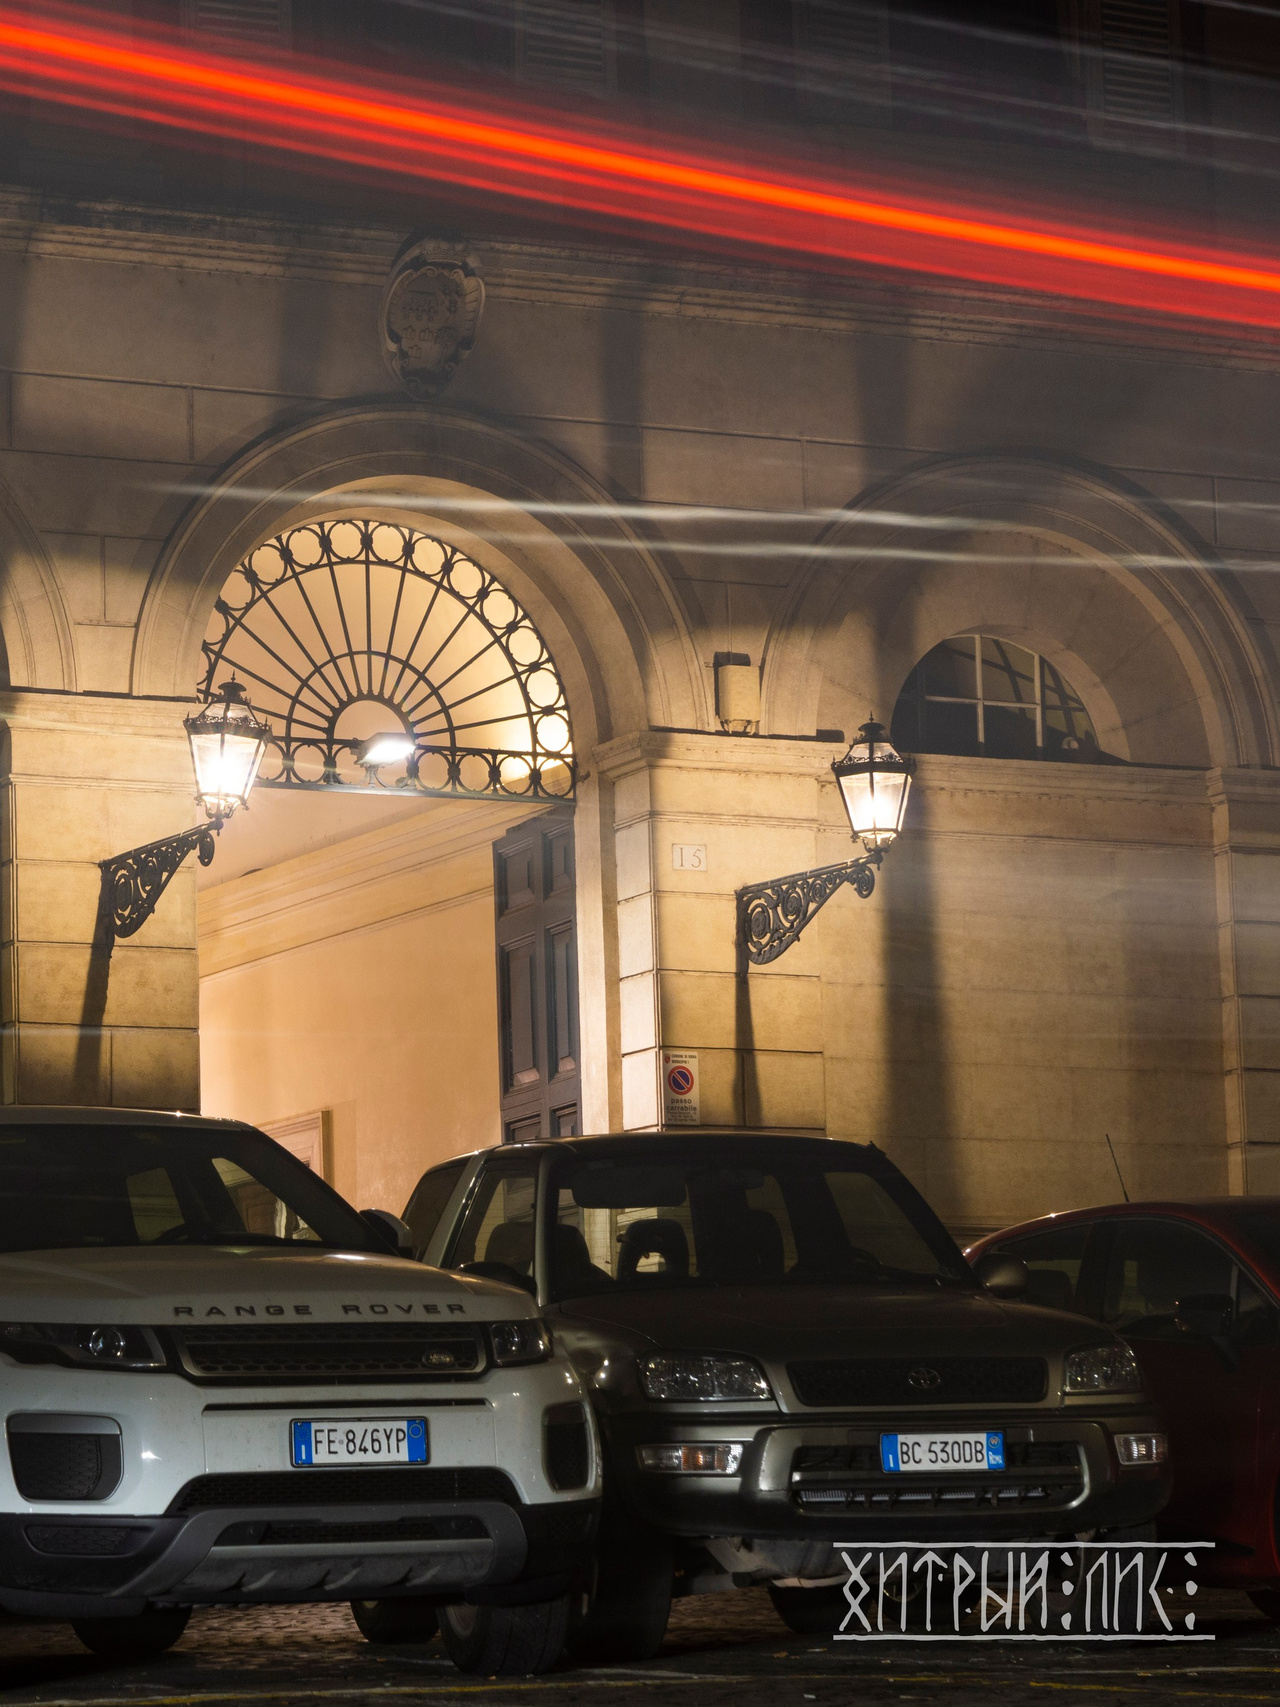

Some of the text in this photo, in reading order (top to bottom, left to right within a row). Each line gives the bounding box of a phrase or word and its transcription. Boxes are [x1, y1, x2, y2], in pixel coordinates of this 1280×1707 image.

[679, 846, 703, 869] 15
[173, 1303, 468, 1318] RANGE ROVER
